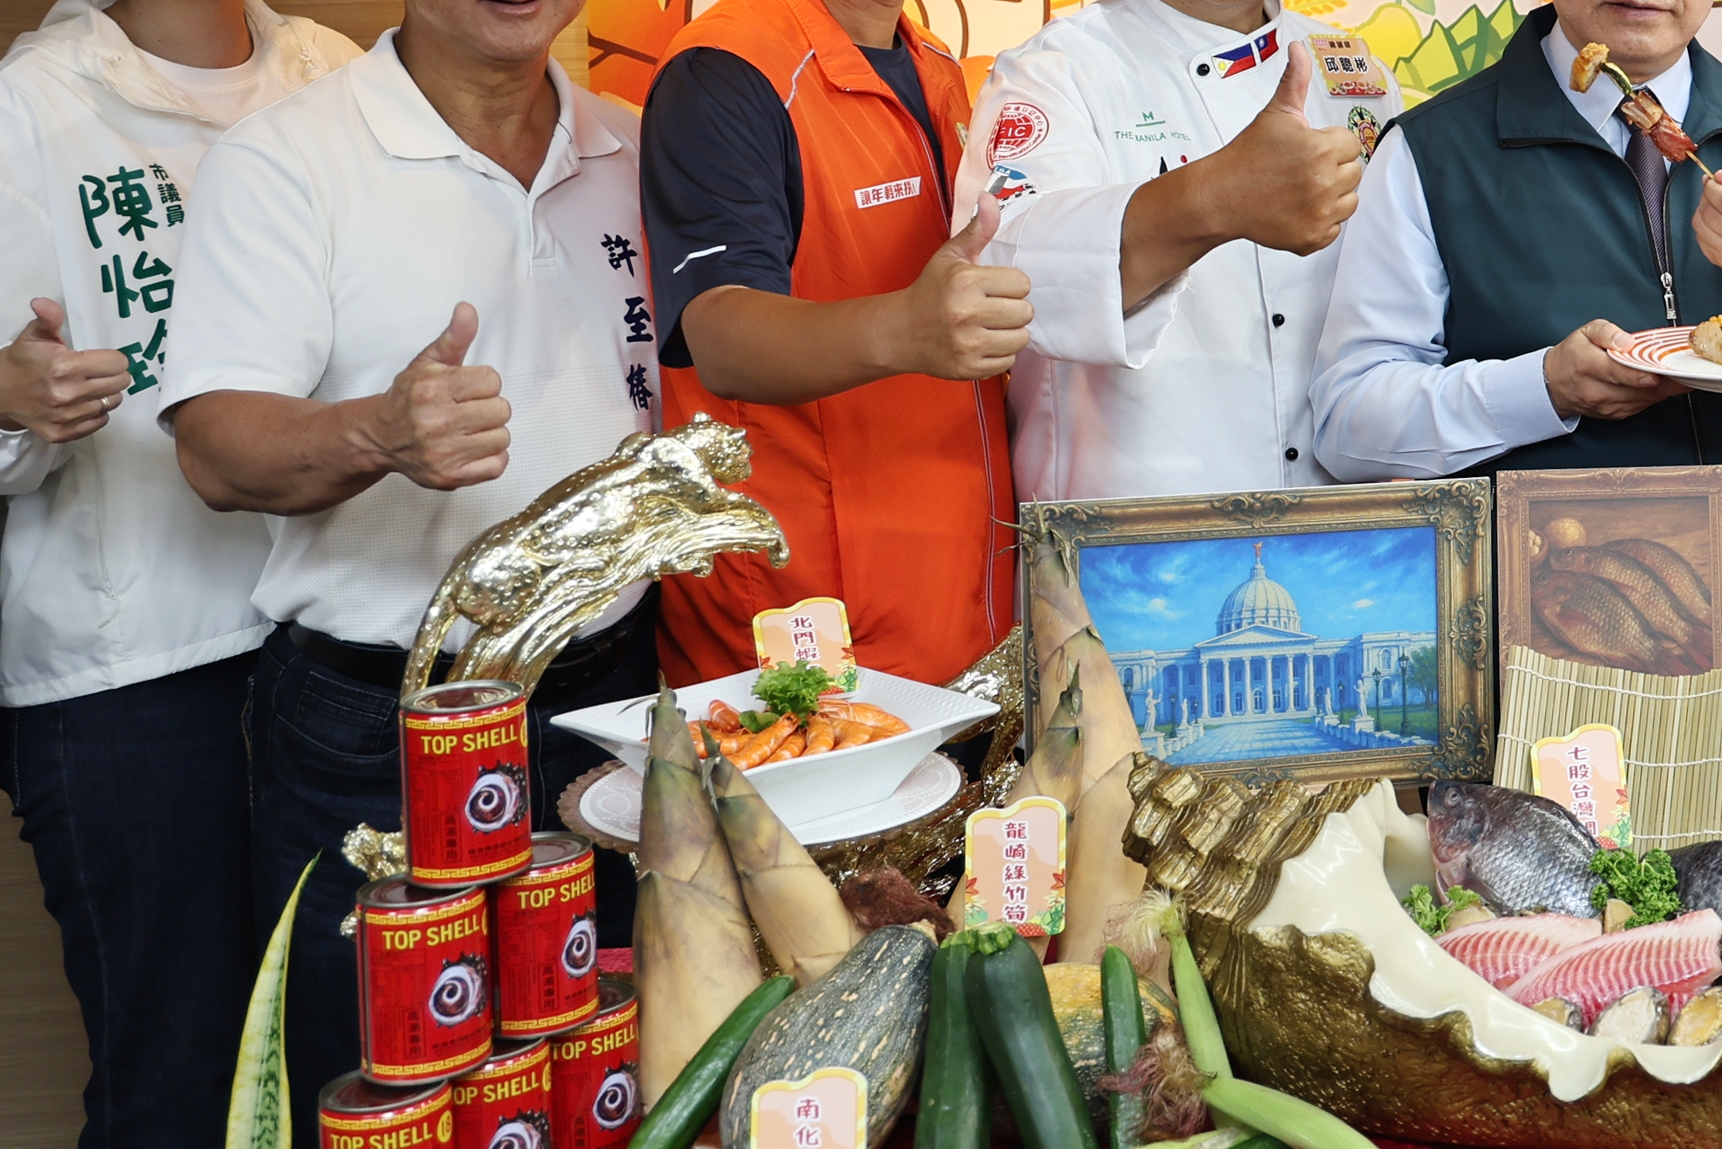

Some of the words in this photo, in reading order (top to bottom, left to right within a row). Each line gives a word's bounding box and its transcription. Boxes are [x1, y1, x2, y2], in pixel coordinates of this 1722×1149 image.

[1114, 131, 1133, 140] THE
[149, 163, 185, 228] 市議員
[600, 233, 653, 411] 許至椿
[789, 617, 818, 668] 北門蝦
[421, 735, 458, 755] TOP
[462, 724, 518, 753] SHELL
[1004, 822, 1028, 921] 龍崎綠竹筍
[517, 887, 556, 910] TOP
[382, 929, 422, 950] TOP
[426, 914, 480, 946] SHELL
[552, 1039, 587, 1061] TOP
[591, 1023, 636, 1056] SHELL
[453, 1086, 478, 1106] OP
[483, 1071, 540, 1104] SHELL
[330, 1132, 364, 1149] TOP
[369, 1122, 433, 1149] SHELL
[795, 1098, 819, 1146] 南化
